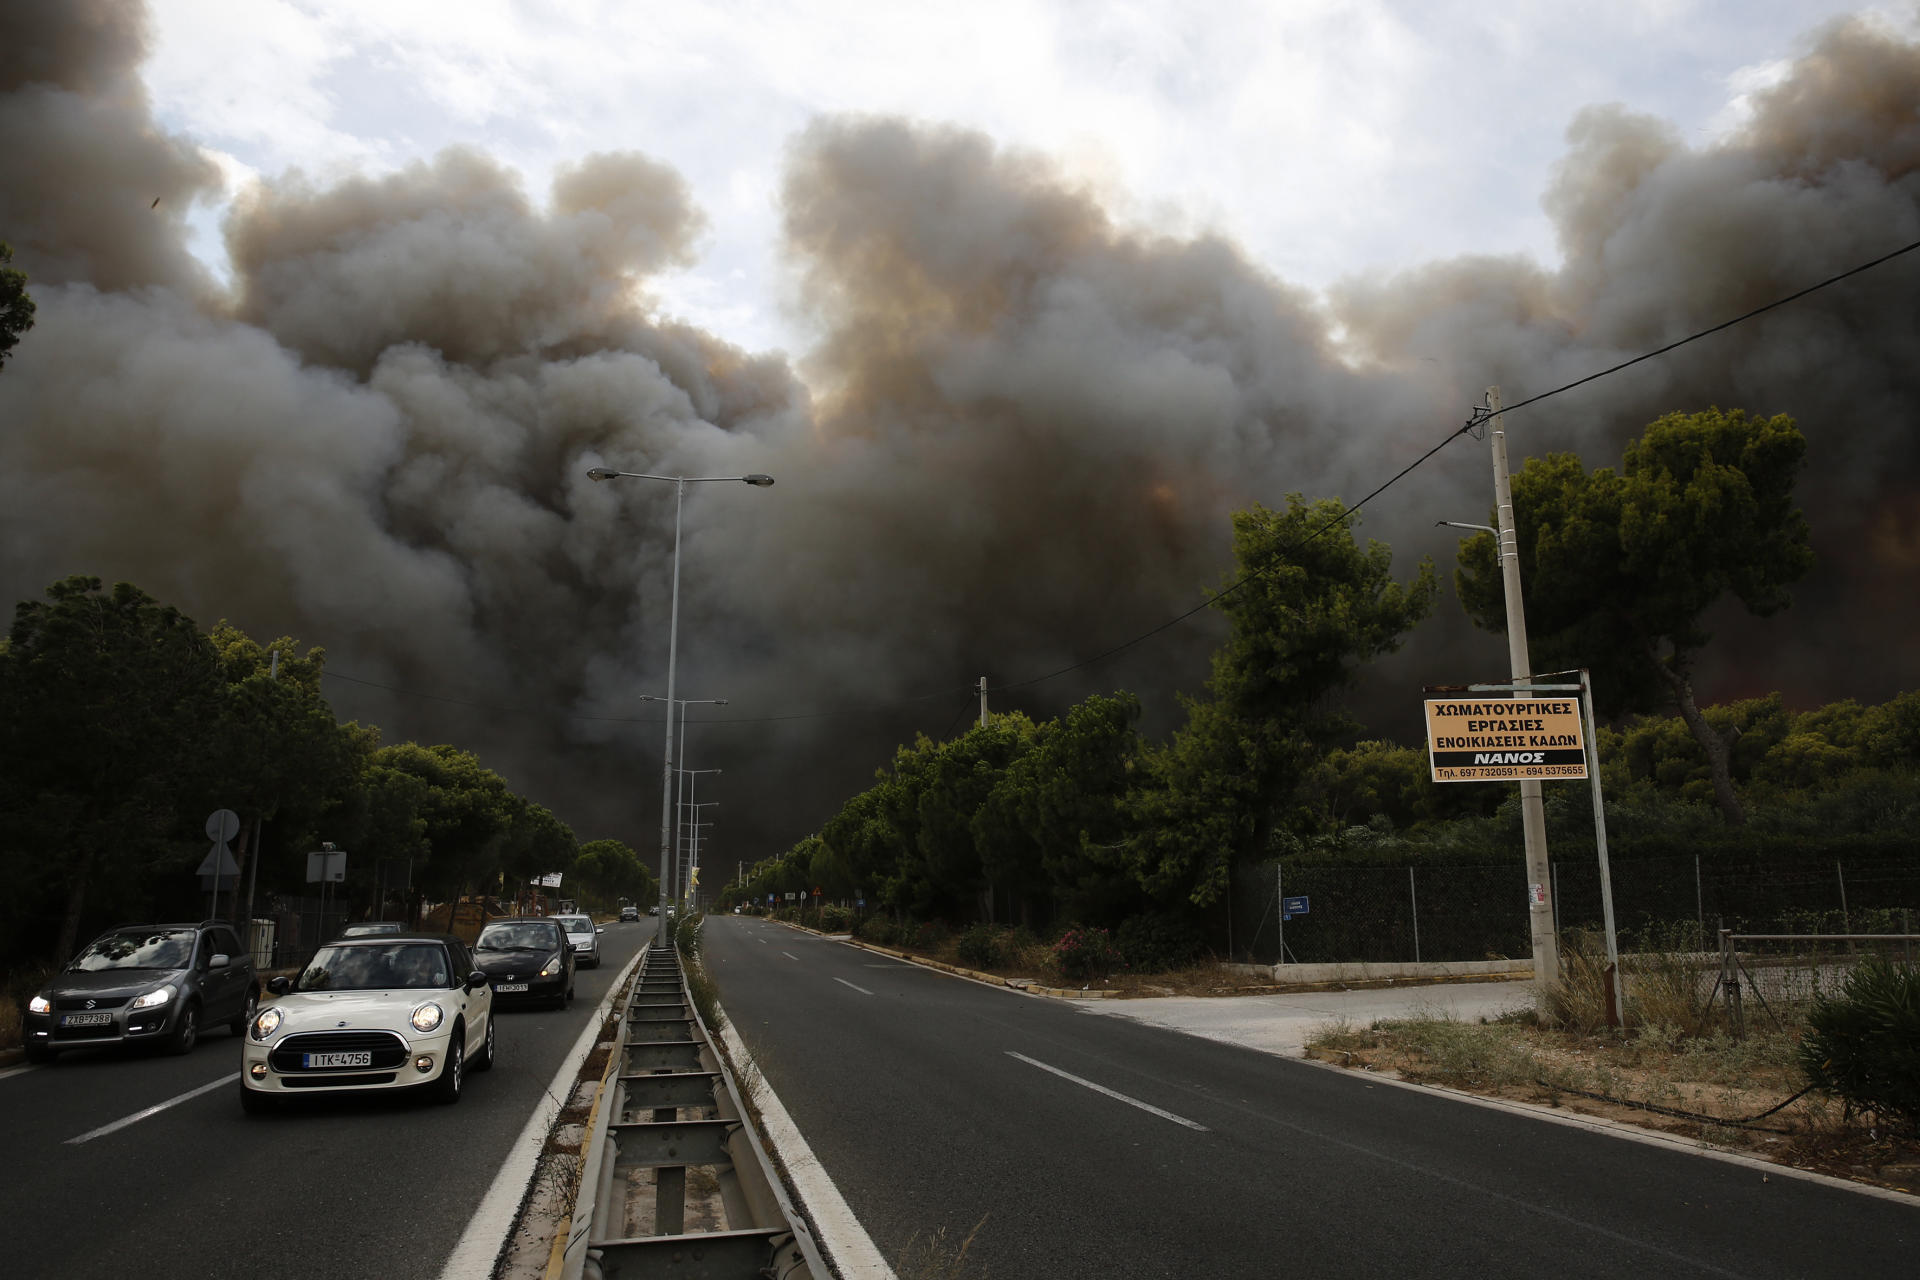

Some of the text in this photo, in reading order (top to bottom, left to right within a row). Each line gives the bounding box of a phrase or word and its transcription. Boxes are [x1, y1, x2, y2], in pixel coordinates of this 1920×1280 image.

[1435, 703, 1572, 716] ΧΩΜΑΤΟΥΡΓΙΚΕΣ
[1468, 719, 1545, 732] ΕΡΓΑΣΙΕΣ
[1437, 735, 1577, 748] ΕΝΟΙΚΙΑΣΕΙΣ ΚΑΔΩΝ
[1474, 752, 1545, 764] ΝΑΝΟΣ
[1438, 769, 1458, 779] Τηλ.
[1460, 769, 1476, 777] 697
[1480, 768, 1518, 777] 7320591
[1526, 767, 1543, 776] 694
[1545, 766, 1584, 775] 5375655
